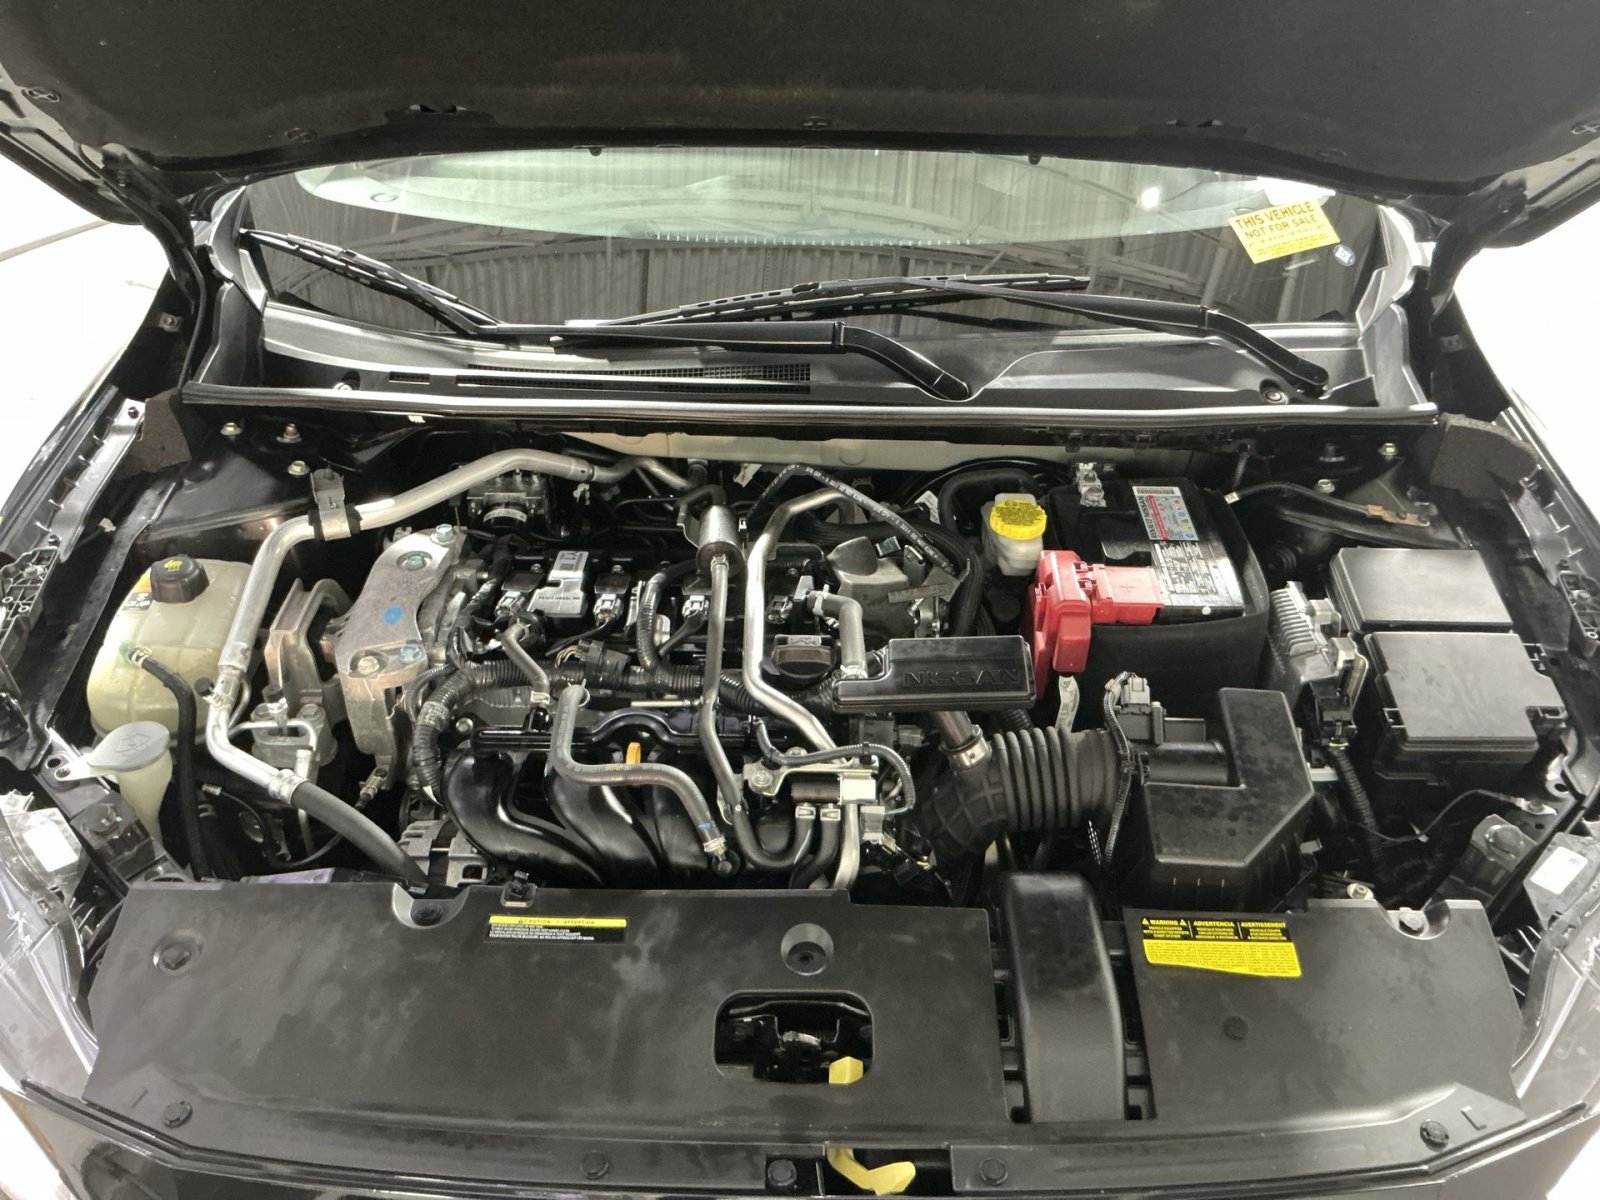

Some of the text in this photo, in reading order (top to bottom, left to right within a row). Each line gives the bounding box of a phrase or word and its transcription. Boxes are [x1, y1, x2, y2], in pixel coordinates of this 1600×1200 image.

[1234, 201, 1314, 230] THIS VEHICLE
[1245, 214, 1318, 239] NOT FOR SALE
[903, 668, 1021, 687] NISSAN
